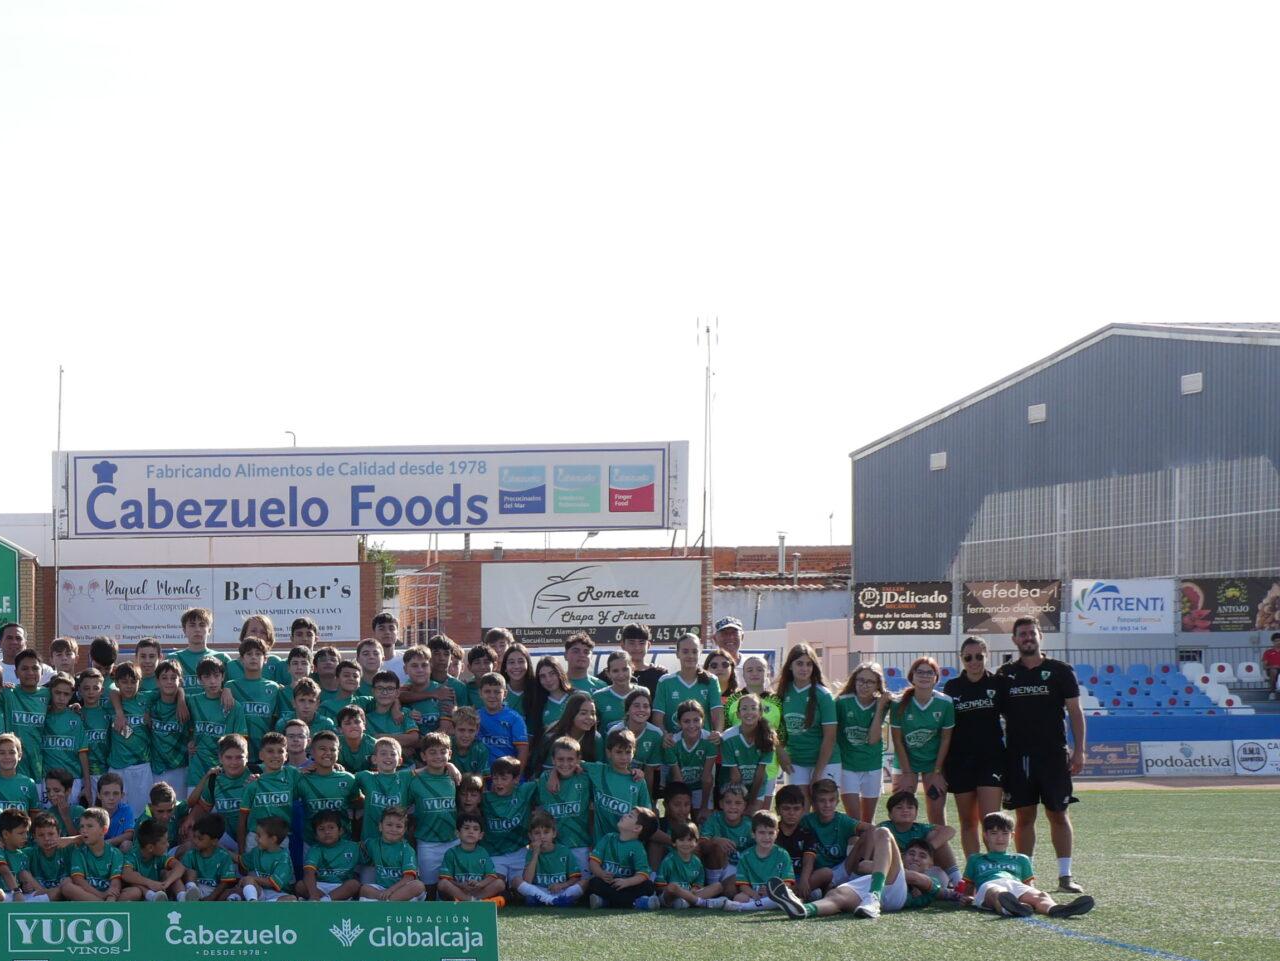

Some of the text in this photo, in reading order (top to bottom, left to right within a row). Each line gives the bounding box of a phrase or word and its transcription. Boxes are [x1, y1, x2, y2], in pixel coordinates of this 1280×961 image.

[147, 460, 488, 479] Fabricando Alimentos de Calidad desde 1978
[86, 483, 489, 530] Cabezuelo Foods
[104, 578, 202, 599] Raquel Morales
[225, 577, 352, 600] Brother's
[578, 586, 639, 602] Romera
[983, 584, 1040, 599] efedea
[880, 590, 948, 605] JDelicado
[967, 603, 1056, 614] fernando delgado
[1217, 605, 1249, 613] ANTOJO
[561, 611, 656, 625] Chapa Y Pintura
[875, 620, 941, 630] 637 084 335
[656, 629, 669, 640] 45
[14, 712, 45, 724] YUGO
[195, 723, 224, 734] YUGO
[1145, 753, 1231, 773] podoactiva
[256, 793, 289, 804] YUGO
[310, 800, 342, 810] YUGO
[424, 799, 456, 809] YUGO
[596, 793, 631, 812] YUGO
[549, 802, 581, 814] YUGO
[489, 818, 521, 830] YUGO
[386, 915, 470, 923] FUNDACIÓN
[15, 918, 124, 945] YUGO
[165, 925, 298, 946] Cabezuelo
[368, 926, 484, 953] Globalcaja
